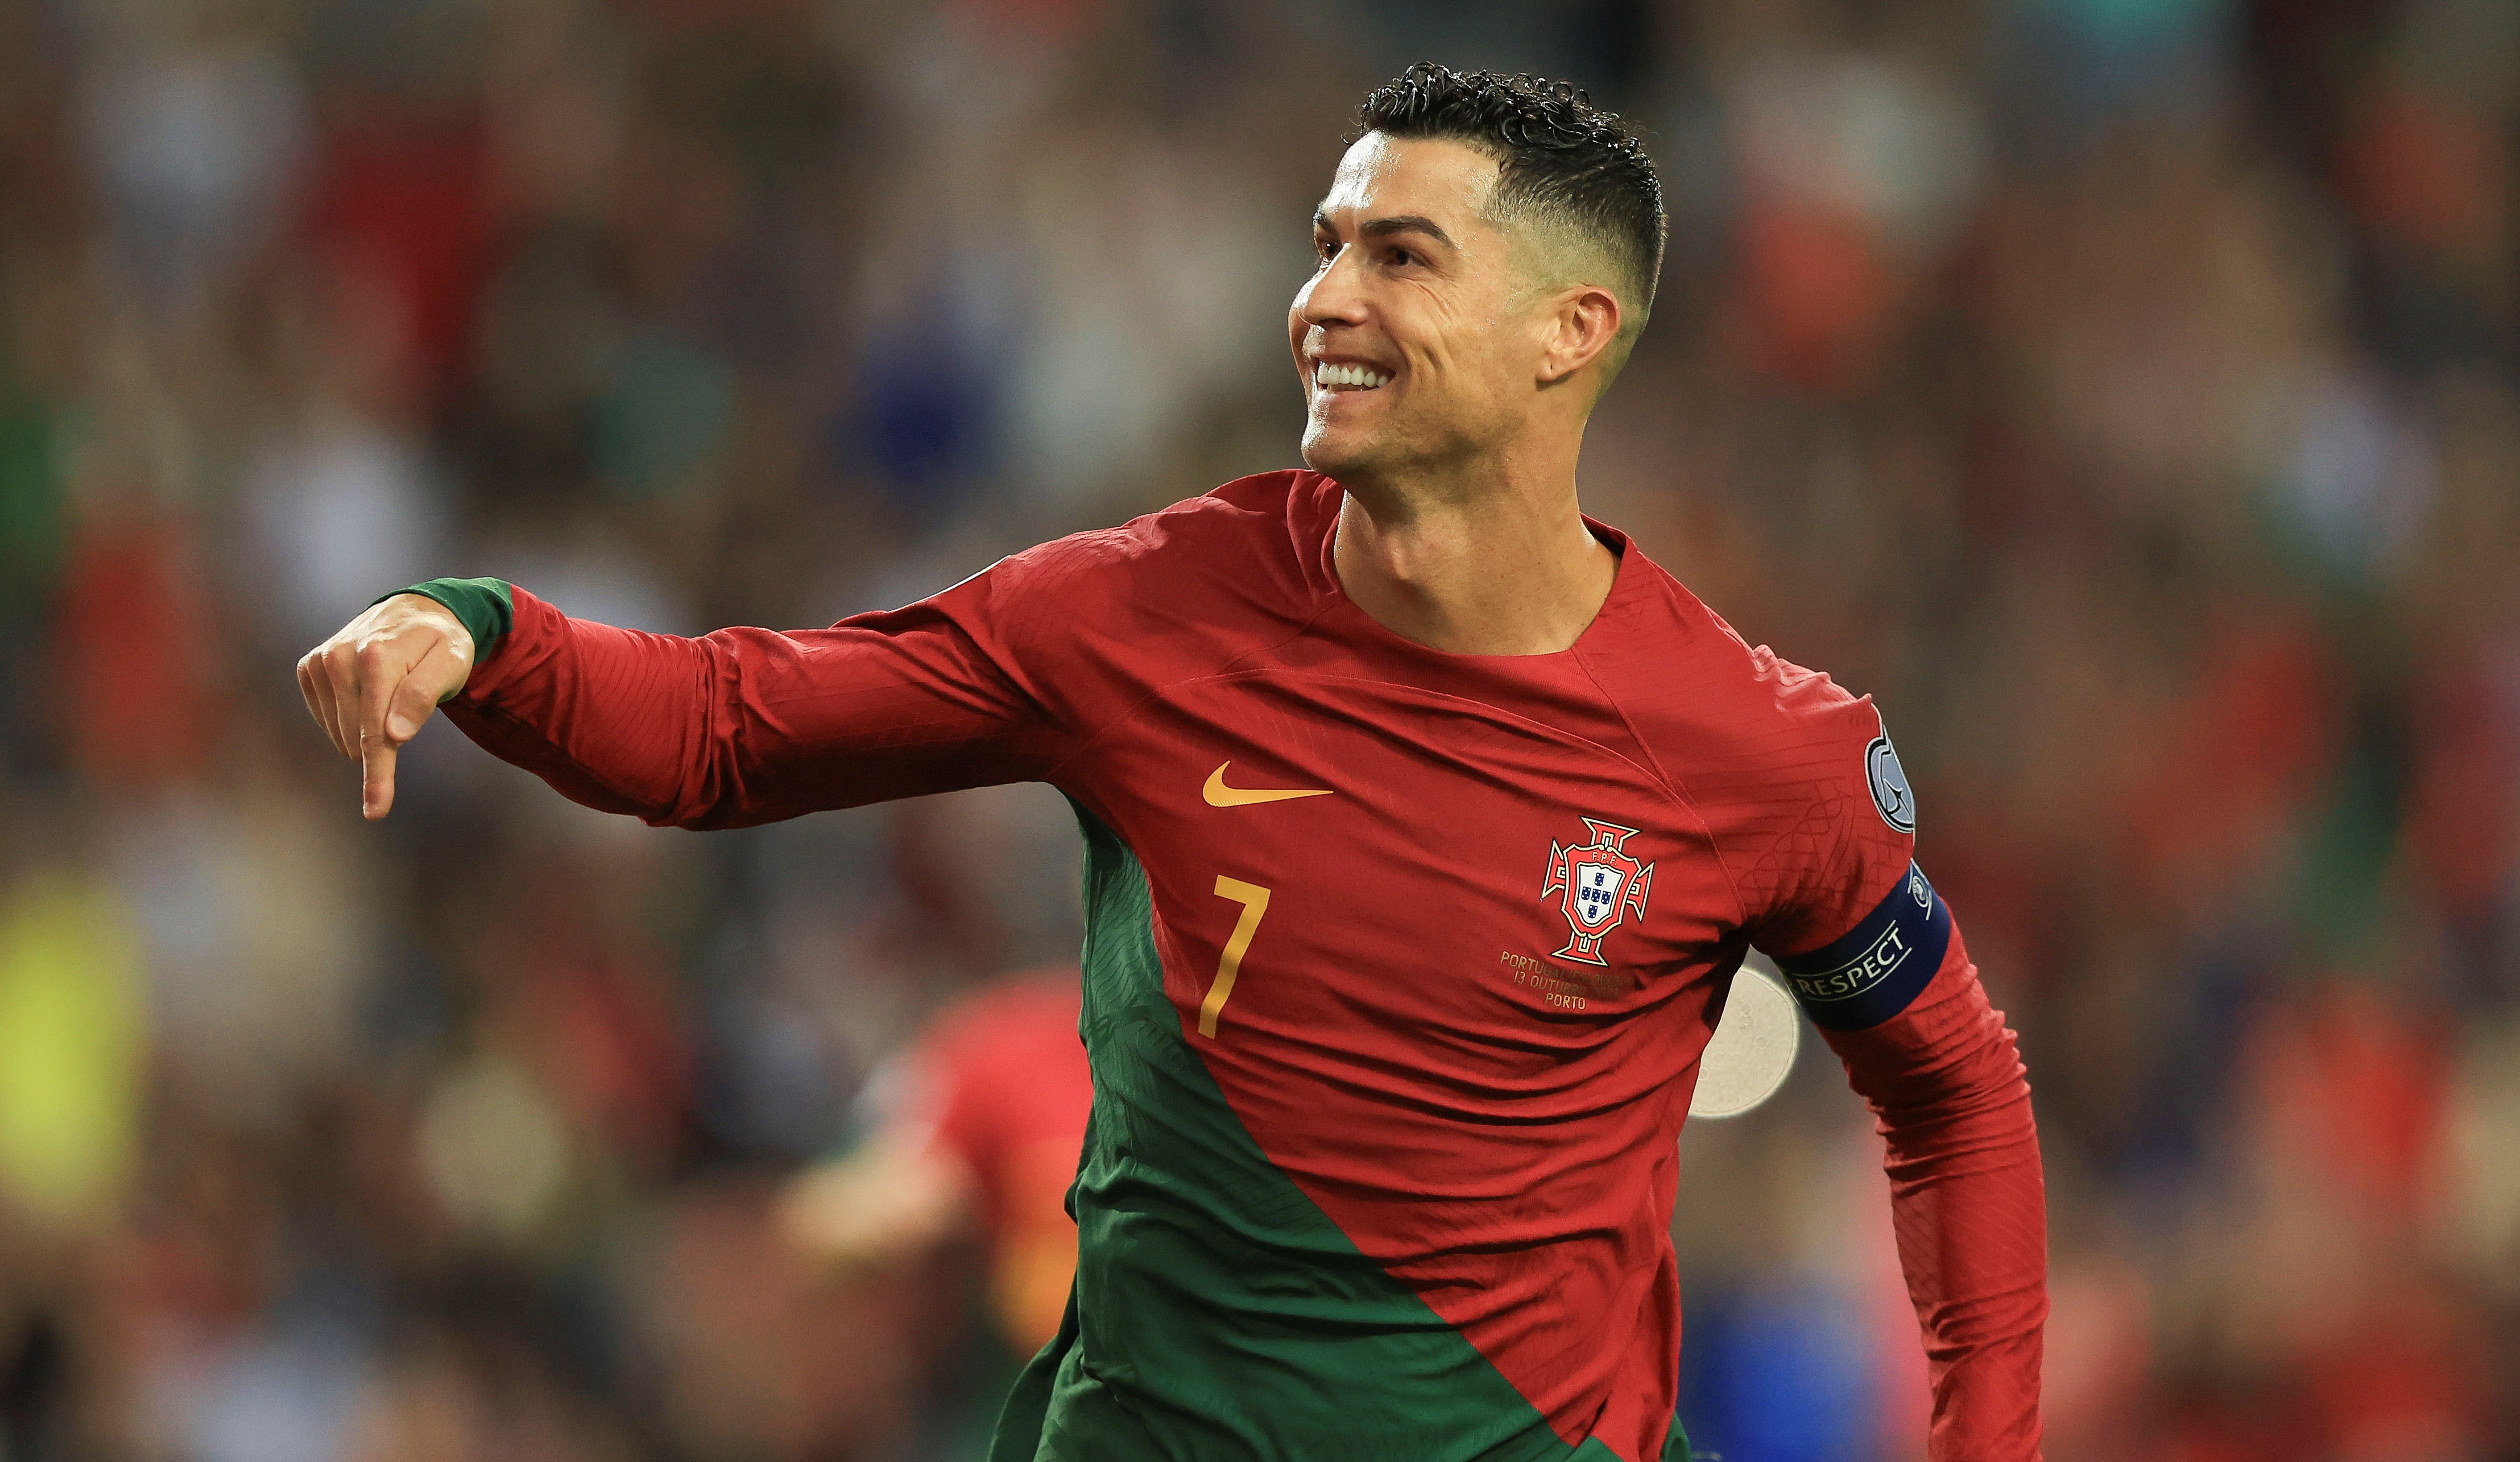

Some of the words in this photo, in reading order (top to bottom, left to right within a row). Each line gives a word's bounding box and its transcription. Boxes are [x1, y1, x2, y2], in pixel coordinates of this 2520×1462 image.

[1592, 852, 1617, 865] F.P.F.
[1198, 874, 1272, 1040] 7
[1796, 927, 1904, 995] RESPECT
[1513, 970, 1526, 984] 13
[1545, 992, 1586, 1010] PORTO
